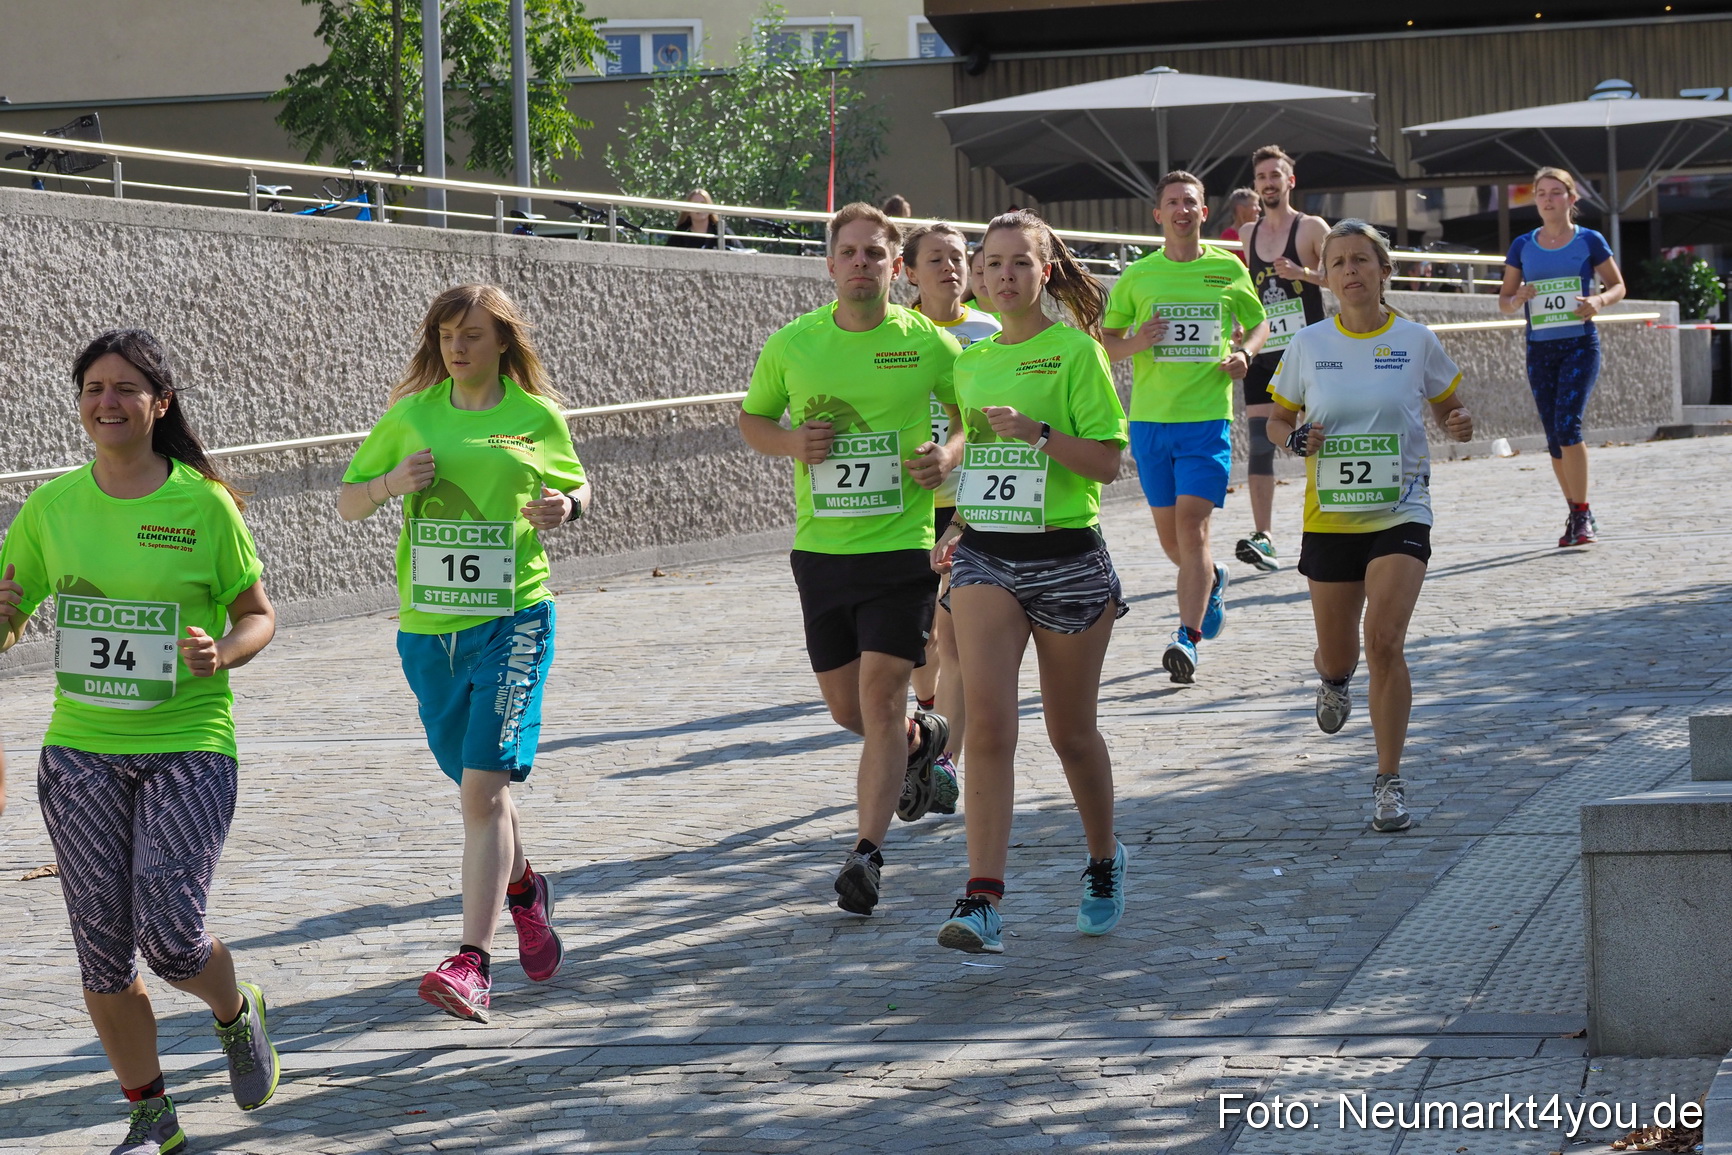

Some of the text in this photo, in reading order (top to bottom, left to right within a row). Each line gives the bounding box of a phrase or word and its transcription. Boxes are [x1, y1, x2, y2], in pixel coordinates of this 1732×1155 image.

[1265, 301, 1300, 318] OCK
[1544, 295, 1566, 311] 40
[1157, 305, 1216, 319] BOCK
[1544, 313, 1569, 323] JULIA
[1174, 323, 1200, 342] 32
[1269, 318, 1287, 334] 41
[1266, 335, 1292, 347] NIKLA
[876, 350, 918, 358] NEUMARKTER
[1160, 346, 1213, 356] YEVGENIY
[1375, 347, 1391, 357] 20
[873, 356, 921, 364] ELEMENTELAUF
[1315, 361, 1344, 369] BOCK
[827, 435, 892, 457] OCK
[1323, 437, 1393, 456] BOCK
[969, 447, 1041, 468] BOCK
[835, 462, 871, 489] 27
[1339, 461, 1373, 485] 52
[982, 474, 1018, 501] 26
[825, 494, 888, 508] MICHAEL
[1332, 491, 1385, 503] SANDRA
[963, 508, 1035, 523] CHRISTINA
[140, 524, 196, 537] NEUMARKTER
[417, 522, 507, 547] BOCK
[136, 532, 198, 546] ELEMENTELAUF
[148, 542, 180, 551] September
[441, 554, 481, 583] 16
[424, 589, 499, 605] STEFANIE
[63, 600, 168, 632] BOCK
[89, 637, 137, 672] 34
[163, 644, 174, 652] E6
[84, 680, 140, 697] DIANA
